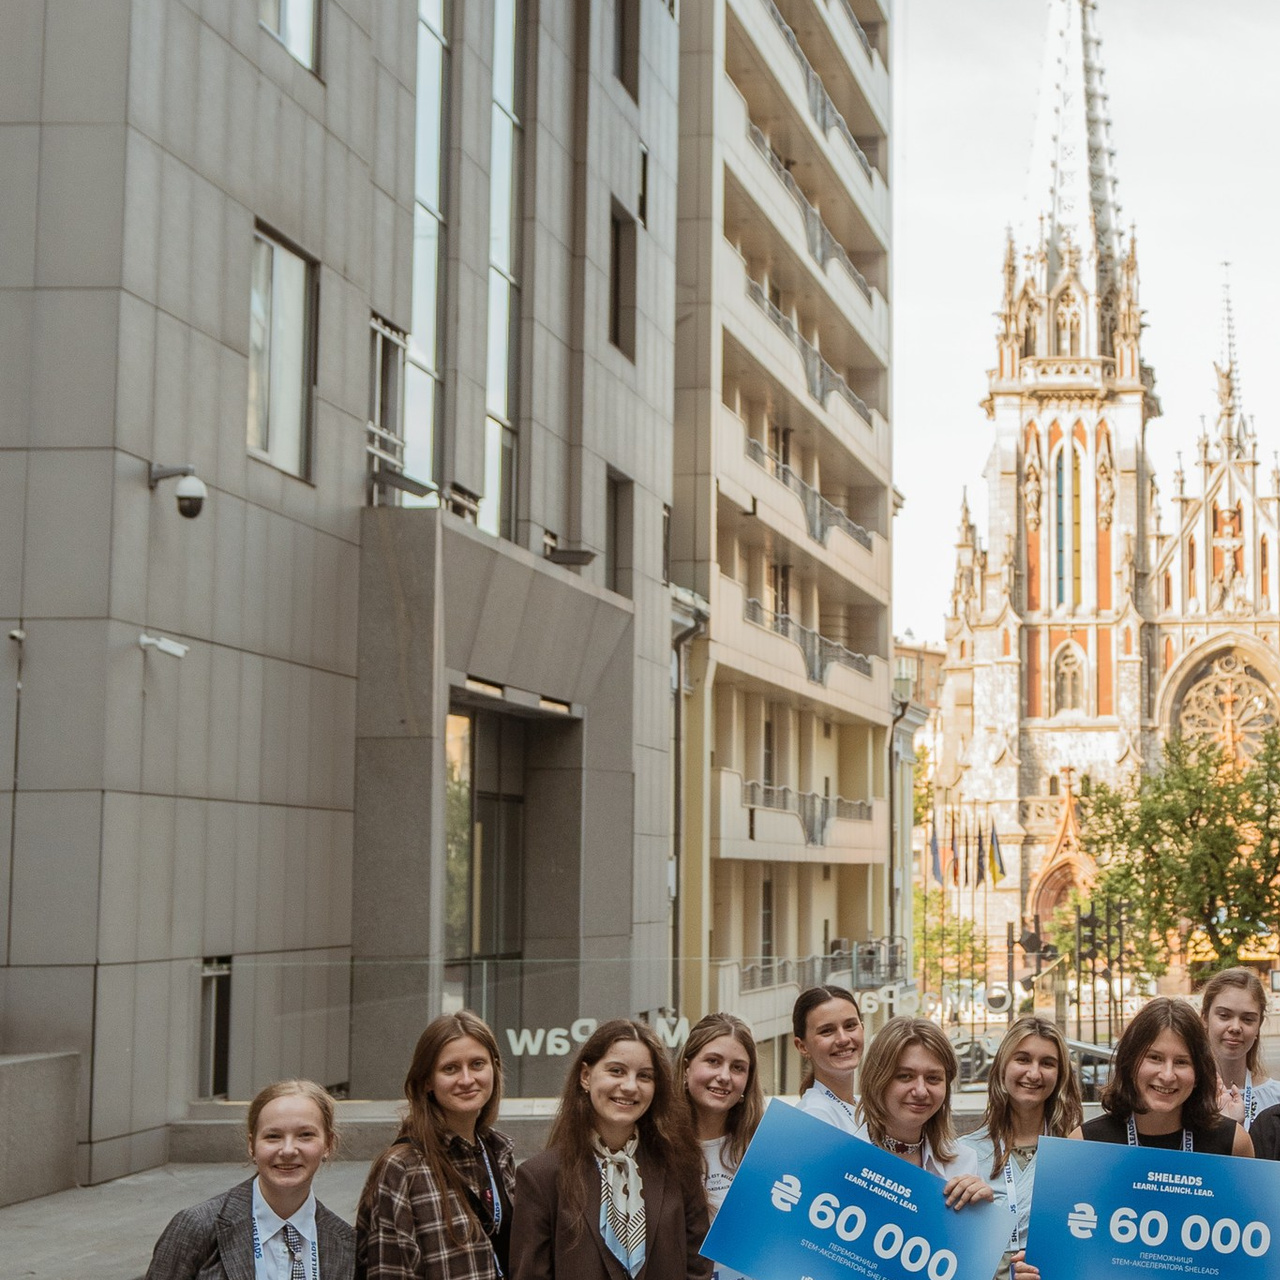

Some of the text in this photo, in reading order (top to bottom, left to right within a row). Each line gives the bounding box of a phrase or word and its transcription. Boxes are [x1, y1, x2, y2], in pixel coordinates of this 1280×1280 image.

[844, 1172, 919, 1213] LEARN. LAUNCH. LEAD.
[860, 1167, 912, 1198] SHELEADS
[1133, 1182, 1215, 1197] LEARN. LAUNCH. LEAD.
[1147, 1171, 1203, 1186] SHELEADS
[770, 1174, 803, 1212] ₴
[808, 1192, 867, 1242] 60
[1067, 1202, 1271, 1258] ₴ 60 000
[800, 1238, 867, 1275] STEM-АКСЕЛЕРАТОРА
[828, 1242, 879, 1271] ПЕРЕМОЖНИЦЯ
[1111, 1258, 1220, 1276] STEM-АКСЕЛЕРАТОРА SHELEADS
[1139, 1252, 1193, 1265] ПЕРЕМОЖНИЦЯ
